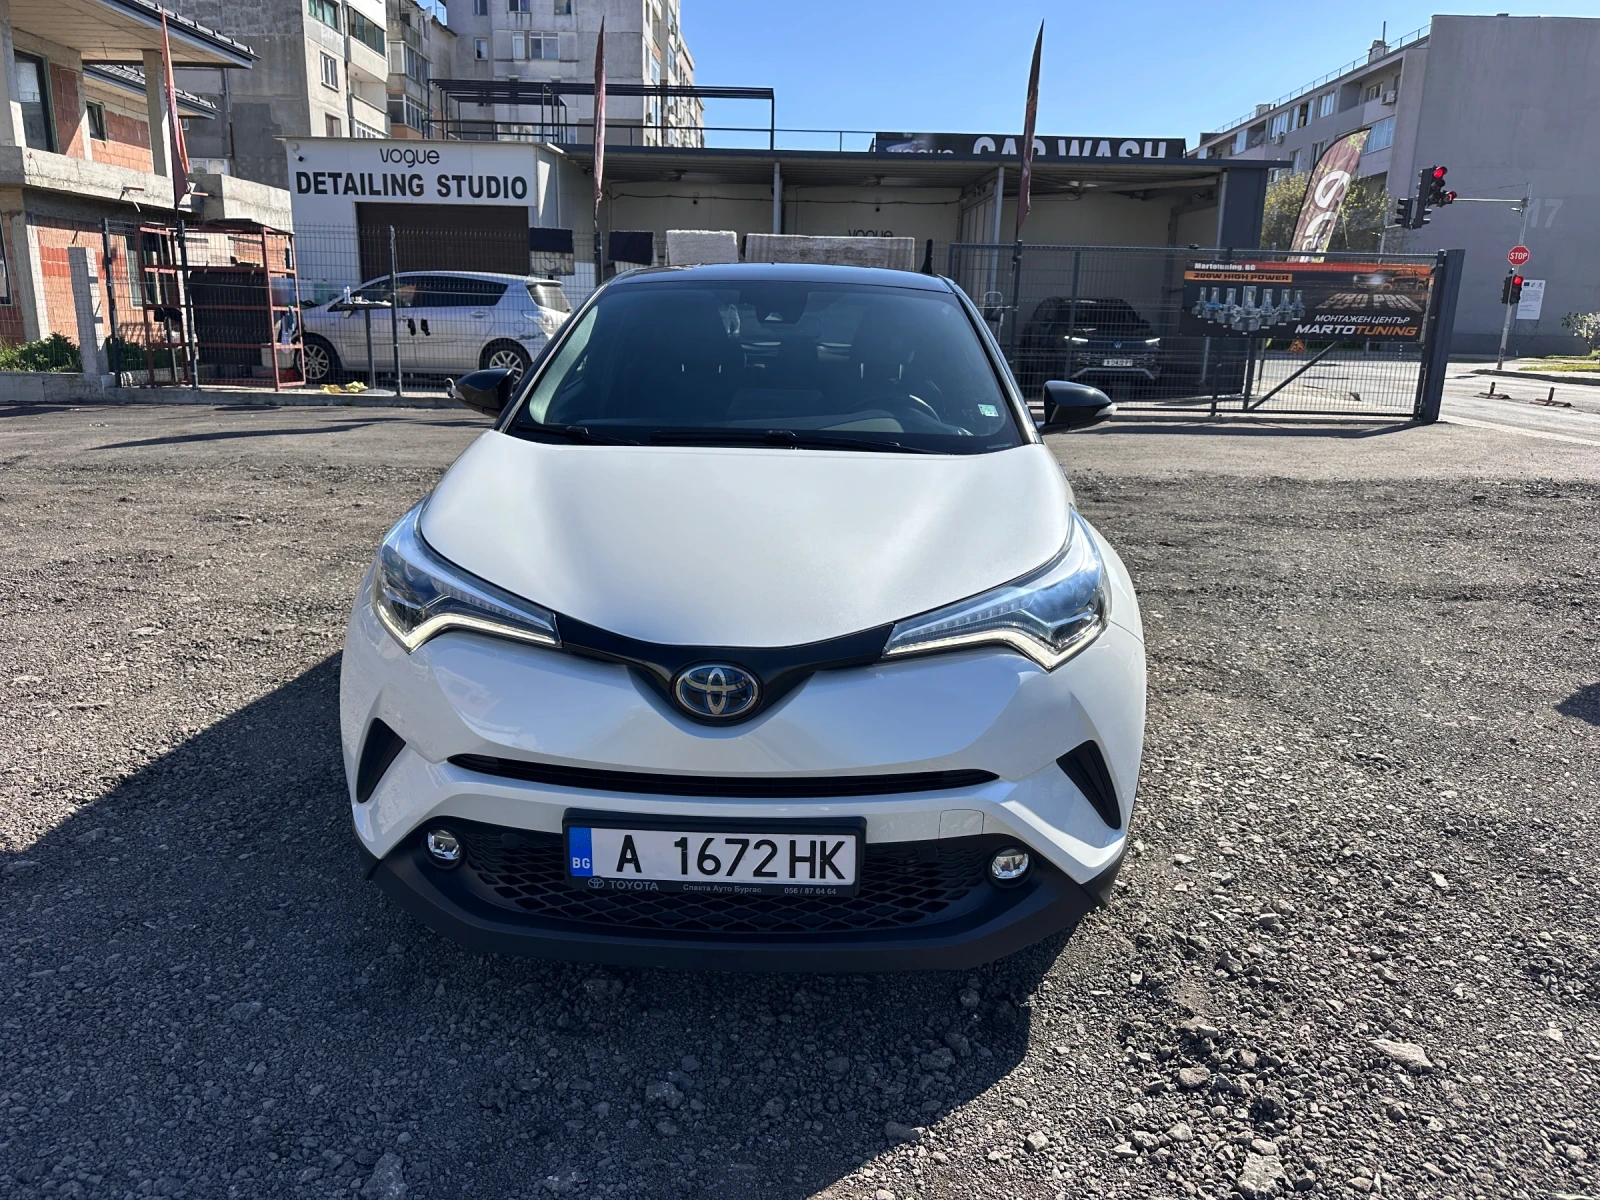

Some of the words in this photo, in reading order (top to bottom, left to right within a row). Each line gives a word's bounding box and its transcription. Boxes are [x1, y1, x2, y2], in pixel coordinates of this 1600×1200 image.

[973, 136, 1046, 156] CA
[380, 148, 440, 168] vogue
[296, 171, 424, 197] DETAILING
[436, 174, 528, 199] STUDIO
[1509, 251, 1528, 260] STOP
[1250, 273, 1289, 281] POWER
[1314, 314, 1372, 323] МОНТАЖЕН
[1371, 315, 1411, 325] ЦЕНТЪР
[1294, 324, 1418, 336] MARTOTUNING
[571, 856, 591, 869] BG
[616, 834, 643, 874] A
[674, 837, 778, 877] 1672
[788, 839, 846, 879] HK
[609, 879, 659, 892] TOYOTA
[712, 885, 733, 894] Ауто
[734, 885, 762, 895] Бургас
[784, 887, 798, 895] 056
[804, 887, 814, 895] 87
[815, 888, 826, 896] 64
[826, 888, 836, 896] 64
